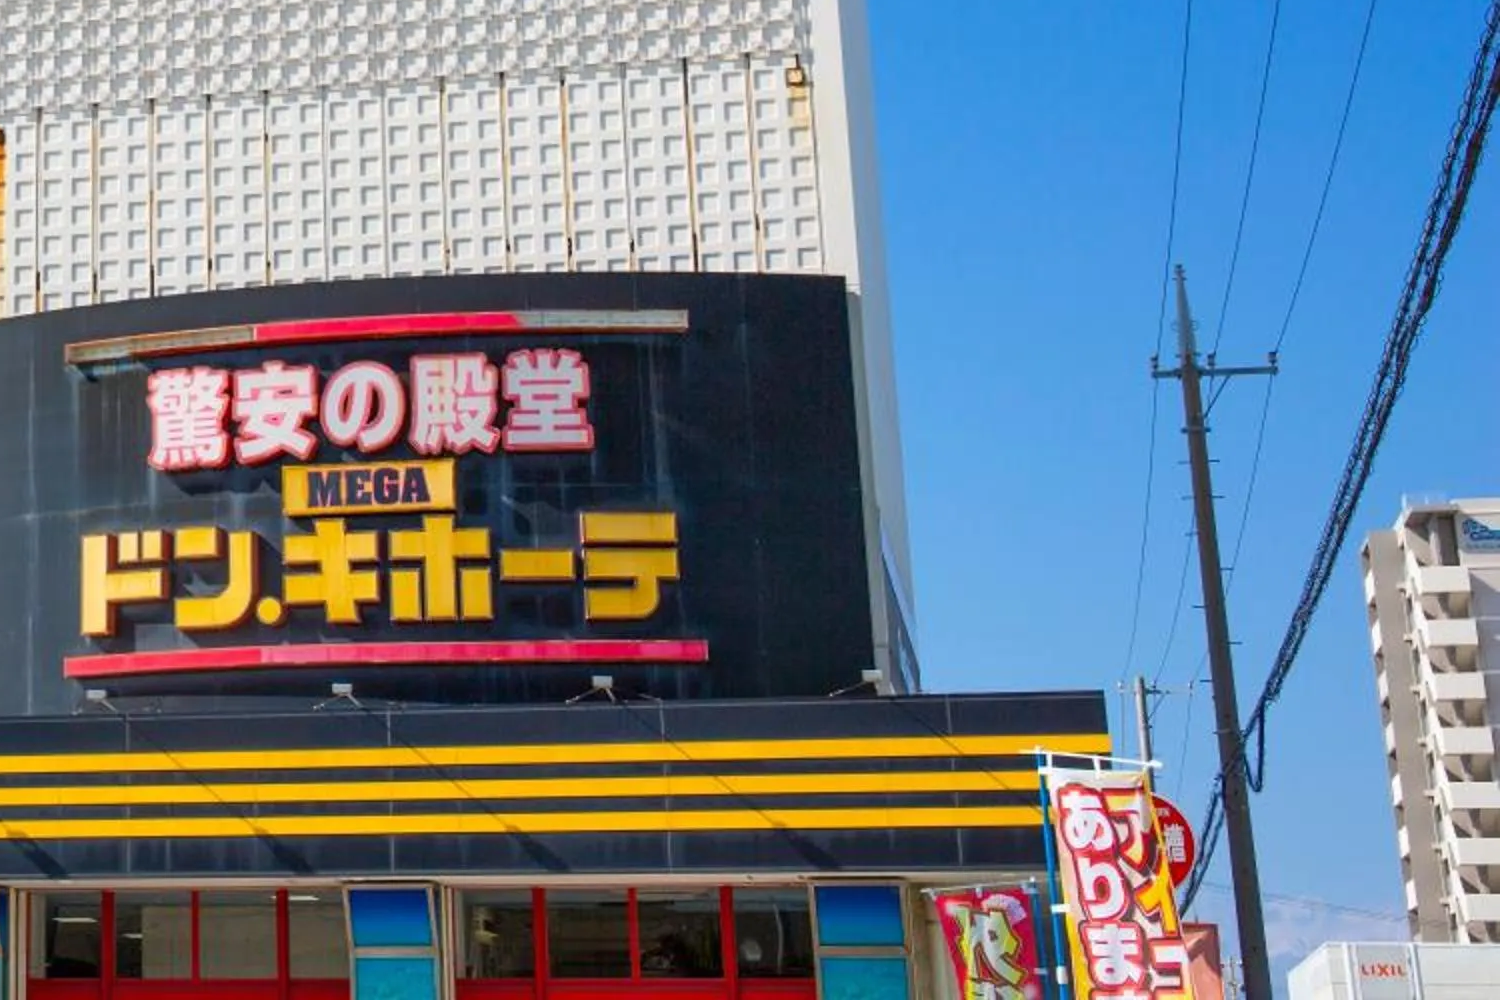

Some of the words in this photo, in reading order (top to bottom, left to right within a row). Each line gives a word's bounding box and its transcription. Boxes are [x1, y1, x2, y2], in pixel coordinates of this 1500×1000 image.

[147, 348, 594, 471] 驚安の殿堂
[306, 467, 432, 508] MEGA
[1058, 787, 1152, 1000] ありま
[1361, 963, 1408, 977] LIXIL
